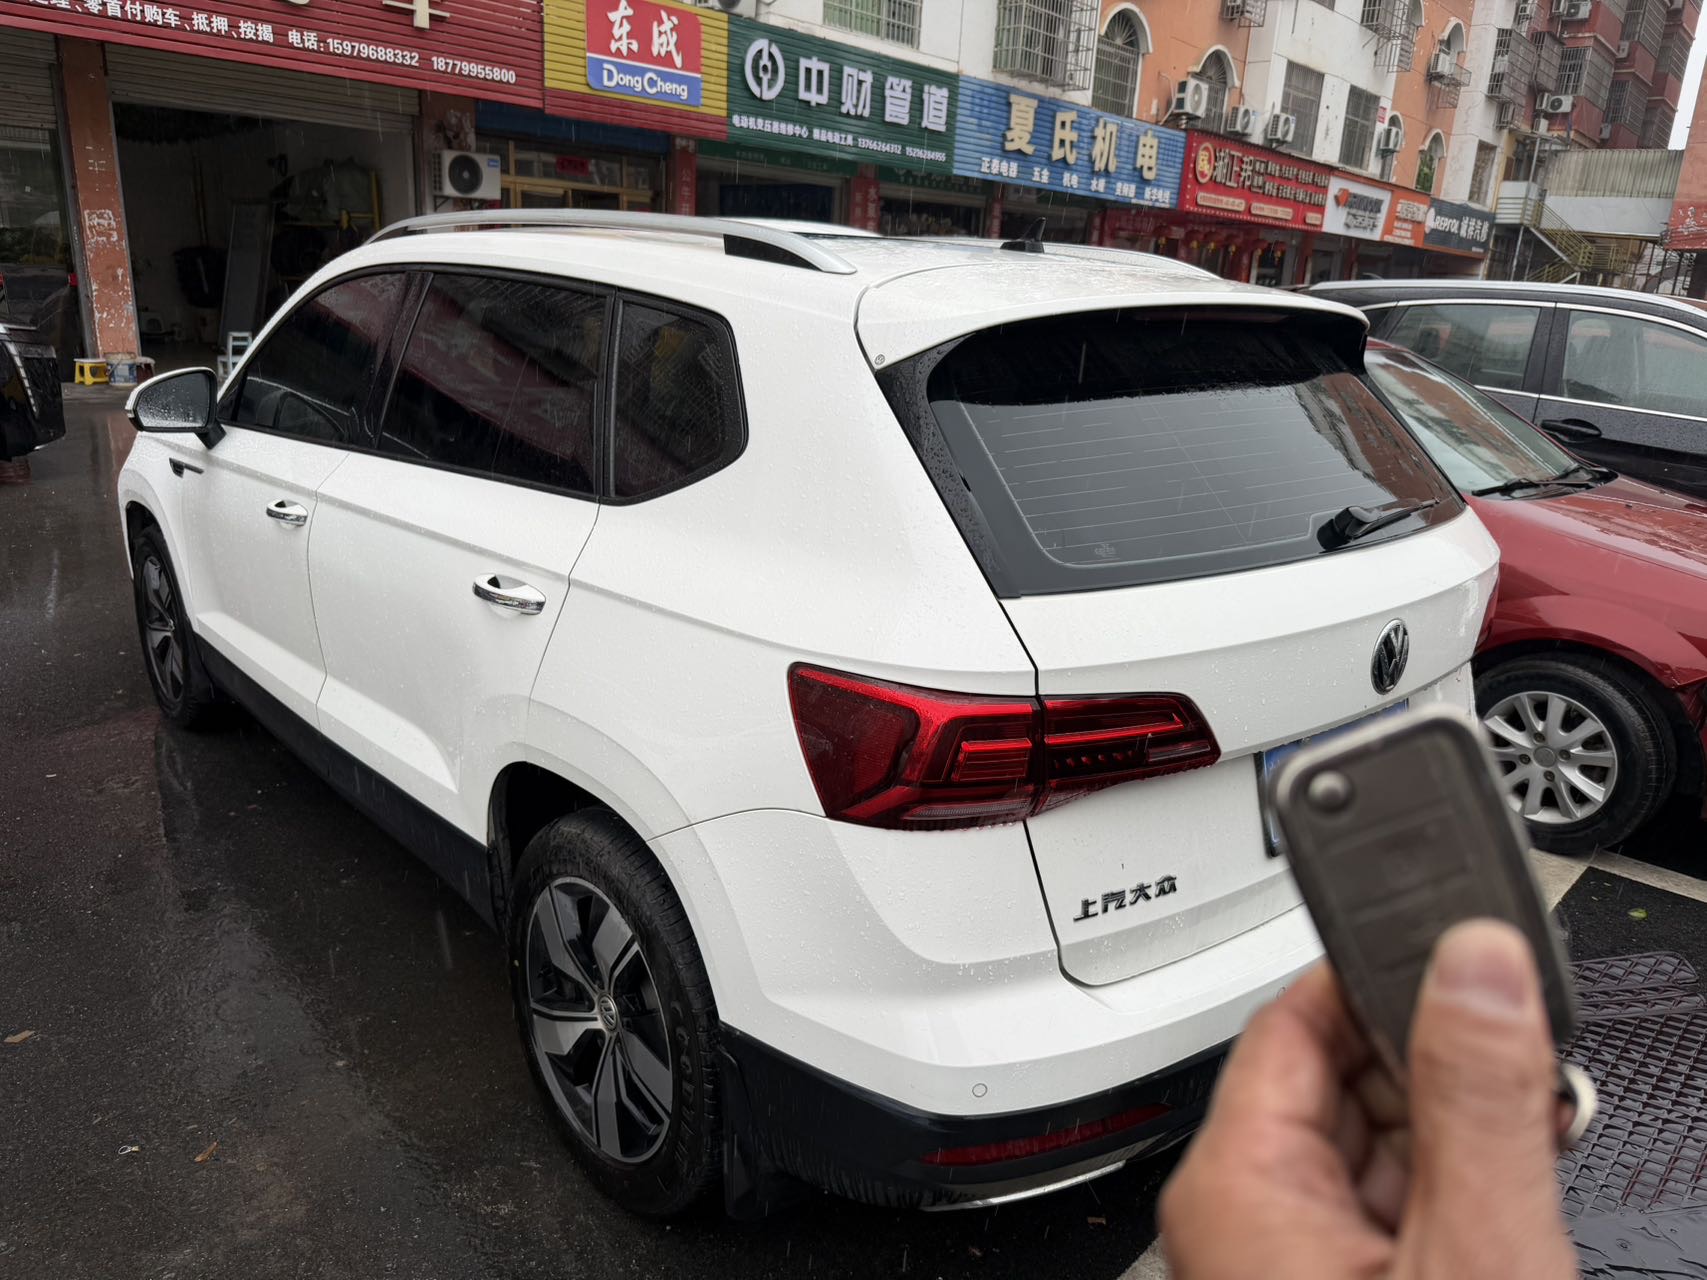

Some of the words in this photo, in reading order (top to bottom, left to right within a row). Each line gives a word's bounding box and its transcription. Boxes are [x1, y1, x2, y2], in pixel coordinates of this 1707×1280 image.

[607, 0, 683, 69] 东成
[431, 56, 516, 84] 18779955800
[602, 63, 688, 100] DongCheng
[798, 56, 950, 133] 中财管道
[1003, 93, 1159, 181] 夏氏机电
[980, 156, 1018, 178] 正泰电器
[1032, 166, 1050, 184] 五金
[1063, 172, 1079, 189] 机电
[1073, 873, 1178, 922] 上汽大众
